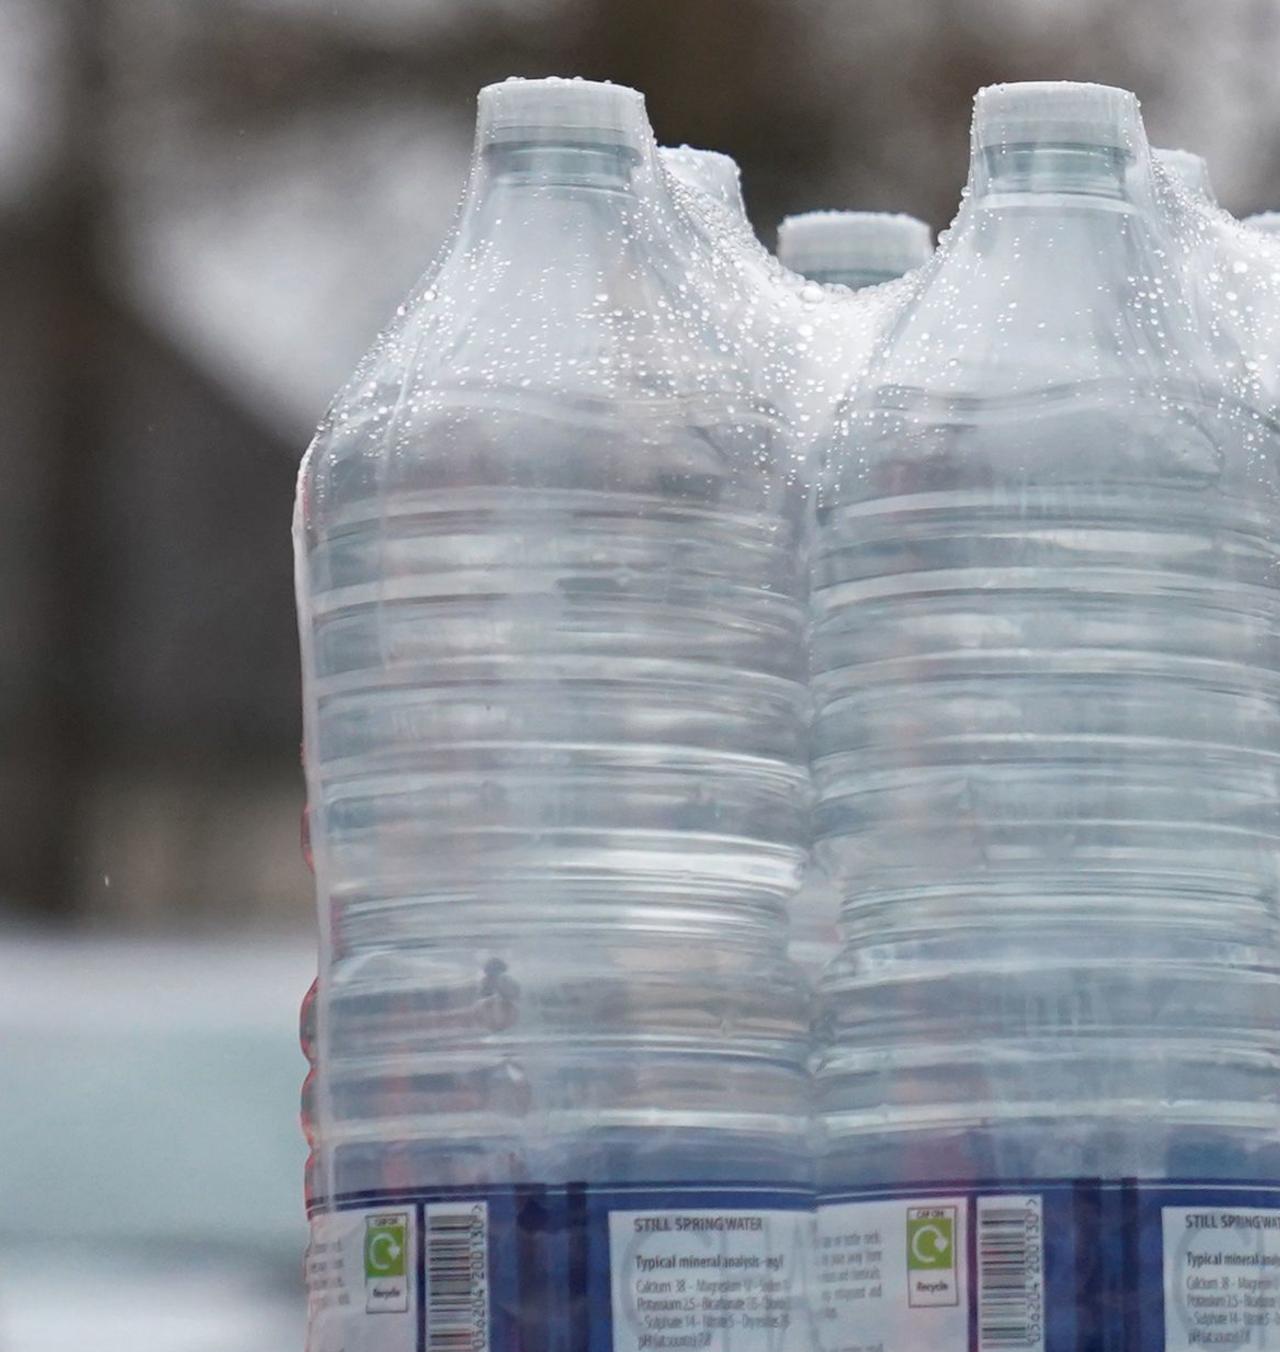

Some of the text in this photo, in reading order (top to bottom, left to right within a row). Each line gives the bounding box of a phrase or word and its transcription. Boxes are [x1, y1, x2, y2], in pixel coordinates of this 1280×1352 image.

[634, 1217, 763, 1233] STILL SPRING WATER
[1185, 1215, 1218, 1229] STILL
[1221, 1215, 1261, 1229] SPRING
[636, 1255, 675, 1270] Typical
[679, 1254, 720, 1269] mineral
[1186, 1252, 1222, 1268] Typical
[1224, 1252, 1259, 1266] mineral
[917, 1280, 948, 1294] Recycle
